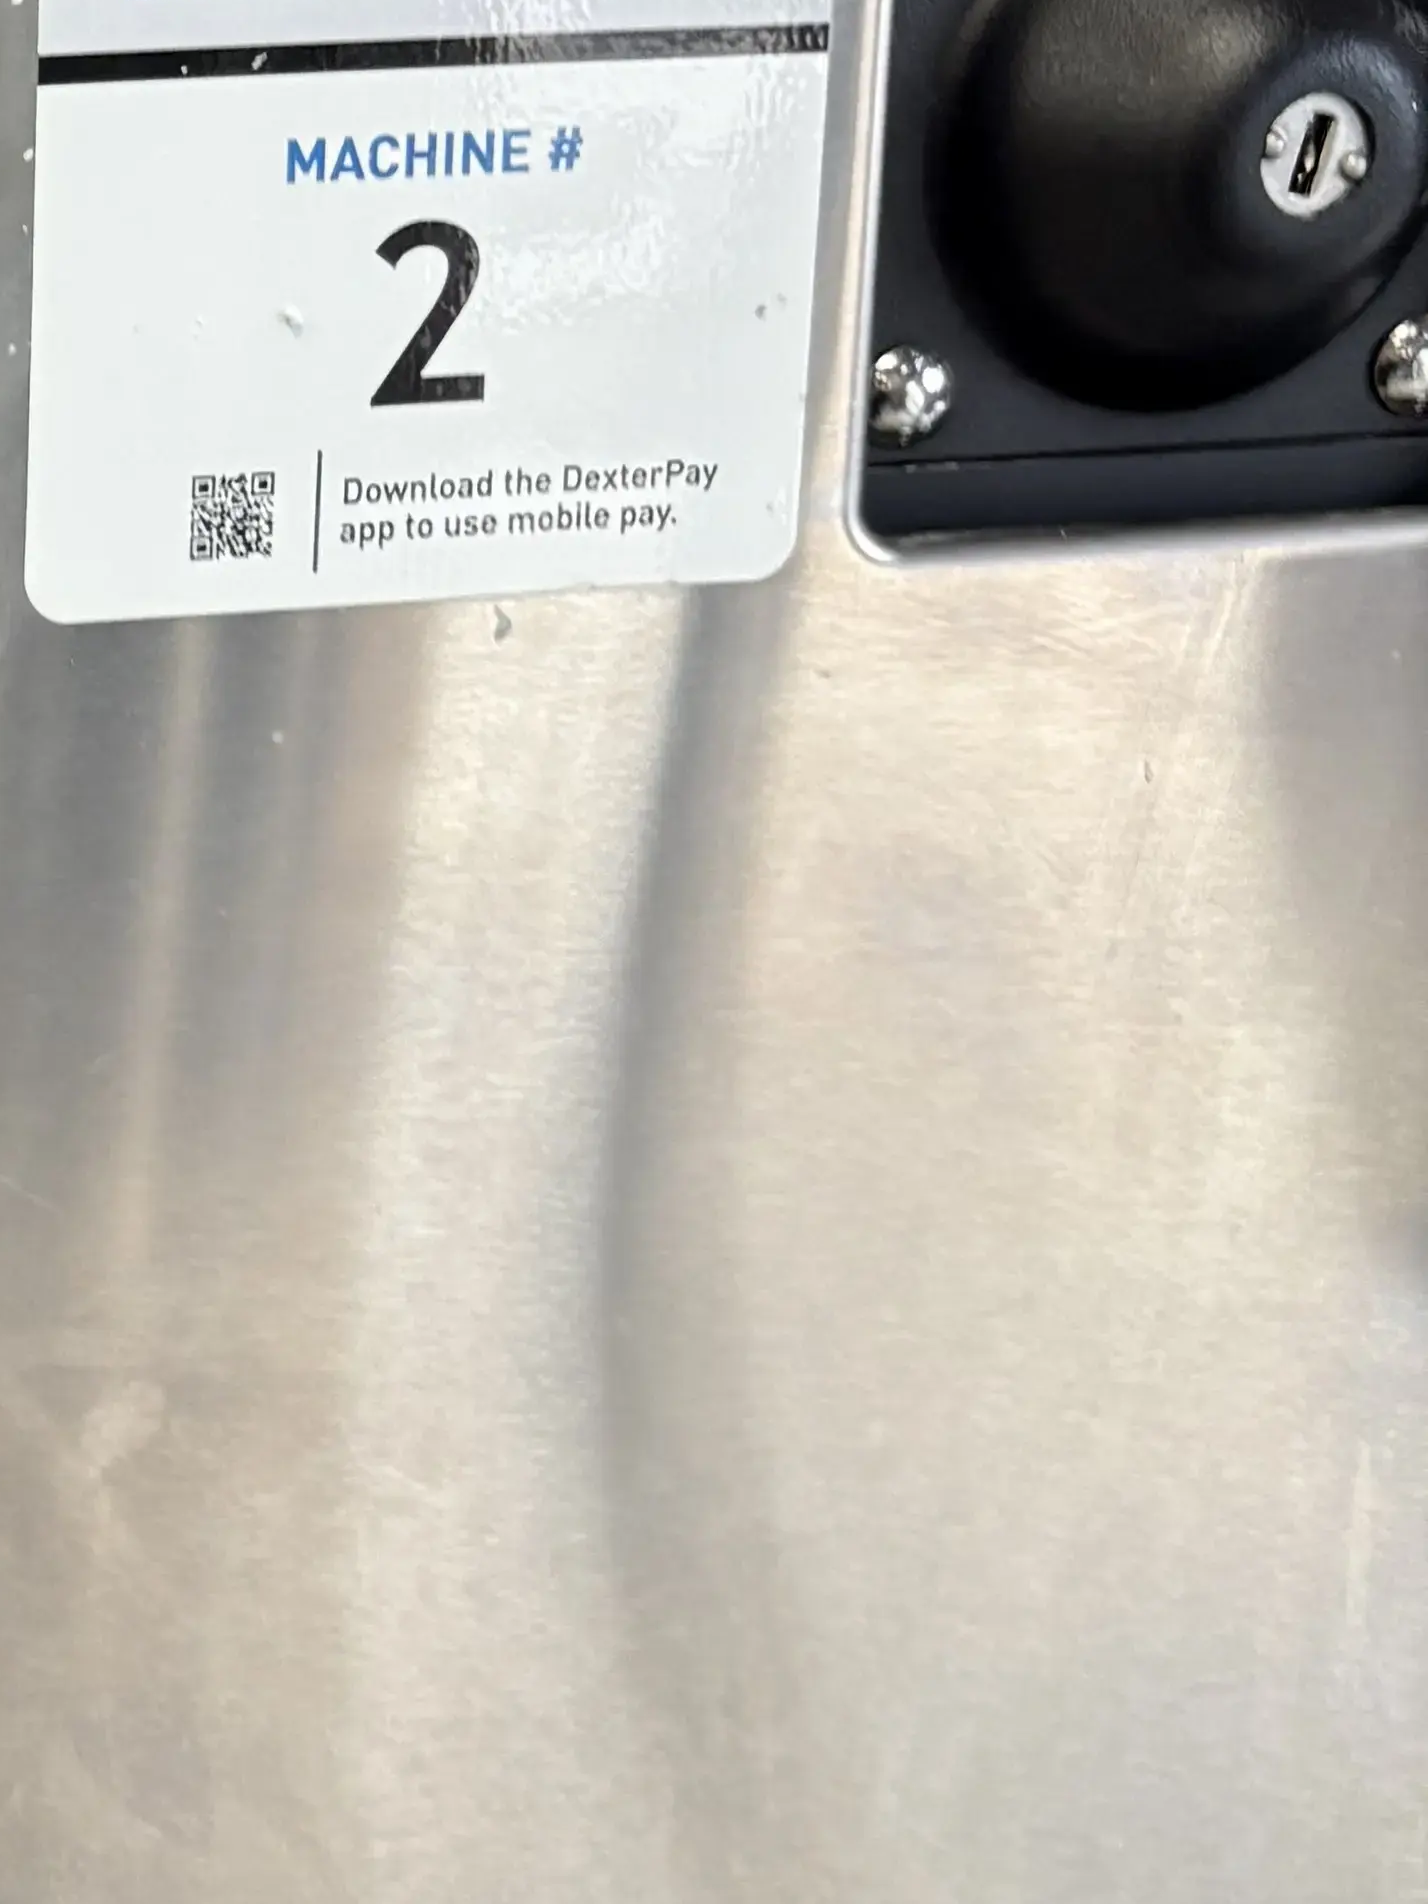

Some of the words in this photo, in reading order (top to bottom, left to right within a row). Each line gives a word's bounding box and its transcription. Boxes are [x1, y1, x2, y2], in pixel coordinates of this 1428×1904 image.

[286, 129, 531, 183] MACHINE
[550, 126, 583, 172] #
[370, 218, 485, 408] 2
[343, 470, 493, 505] Download
[505, 467, 551, 495] the
[563, 459, 718, 492] DexterPay
[340, 521, 394, 550] app
[406, 514, 433, 539] to
[445, 514, 497, 538] use
[508, 502, 610, 535] mobile
[621, 502, 677, 533] pay.
